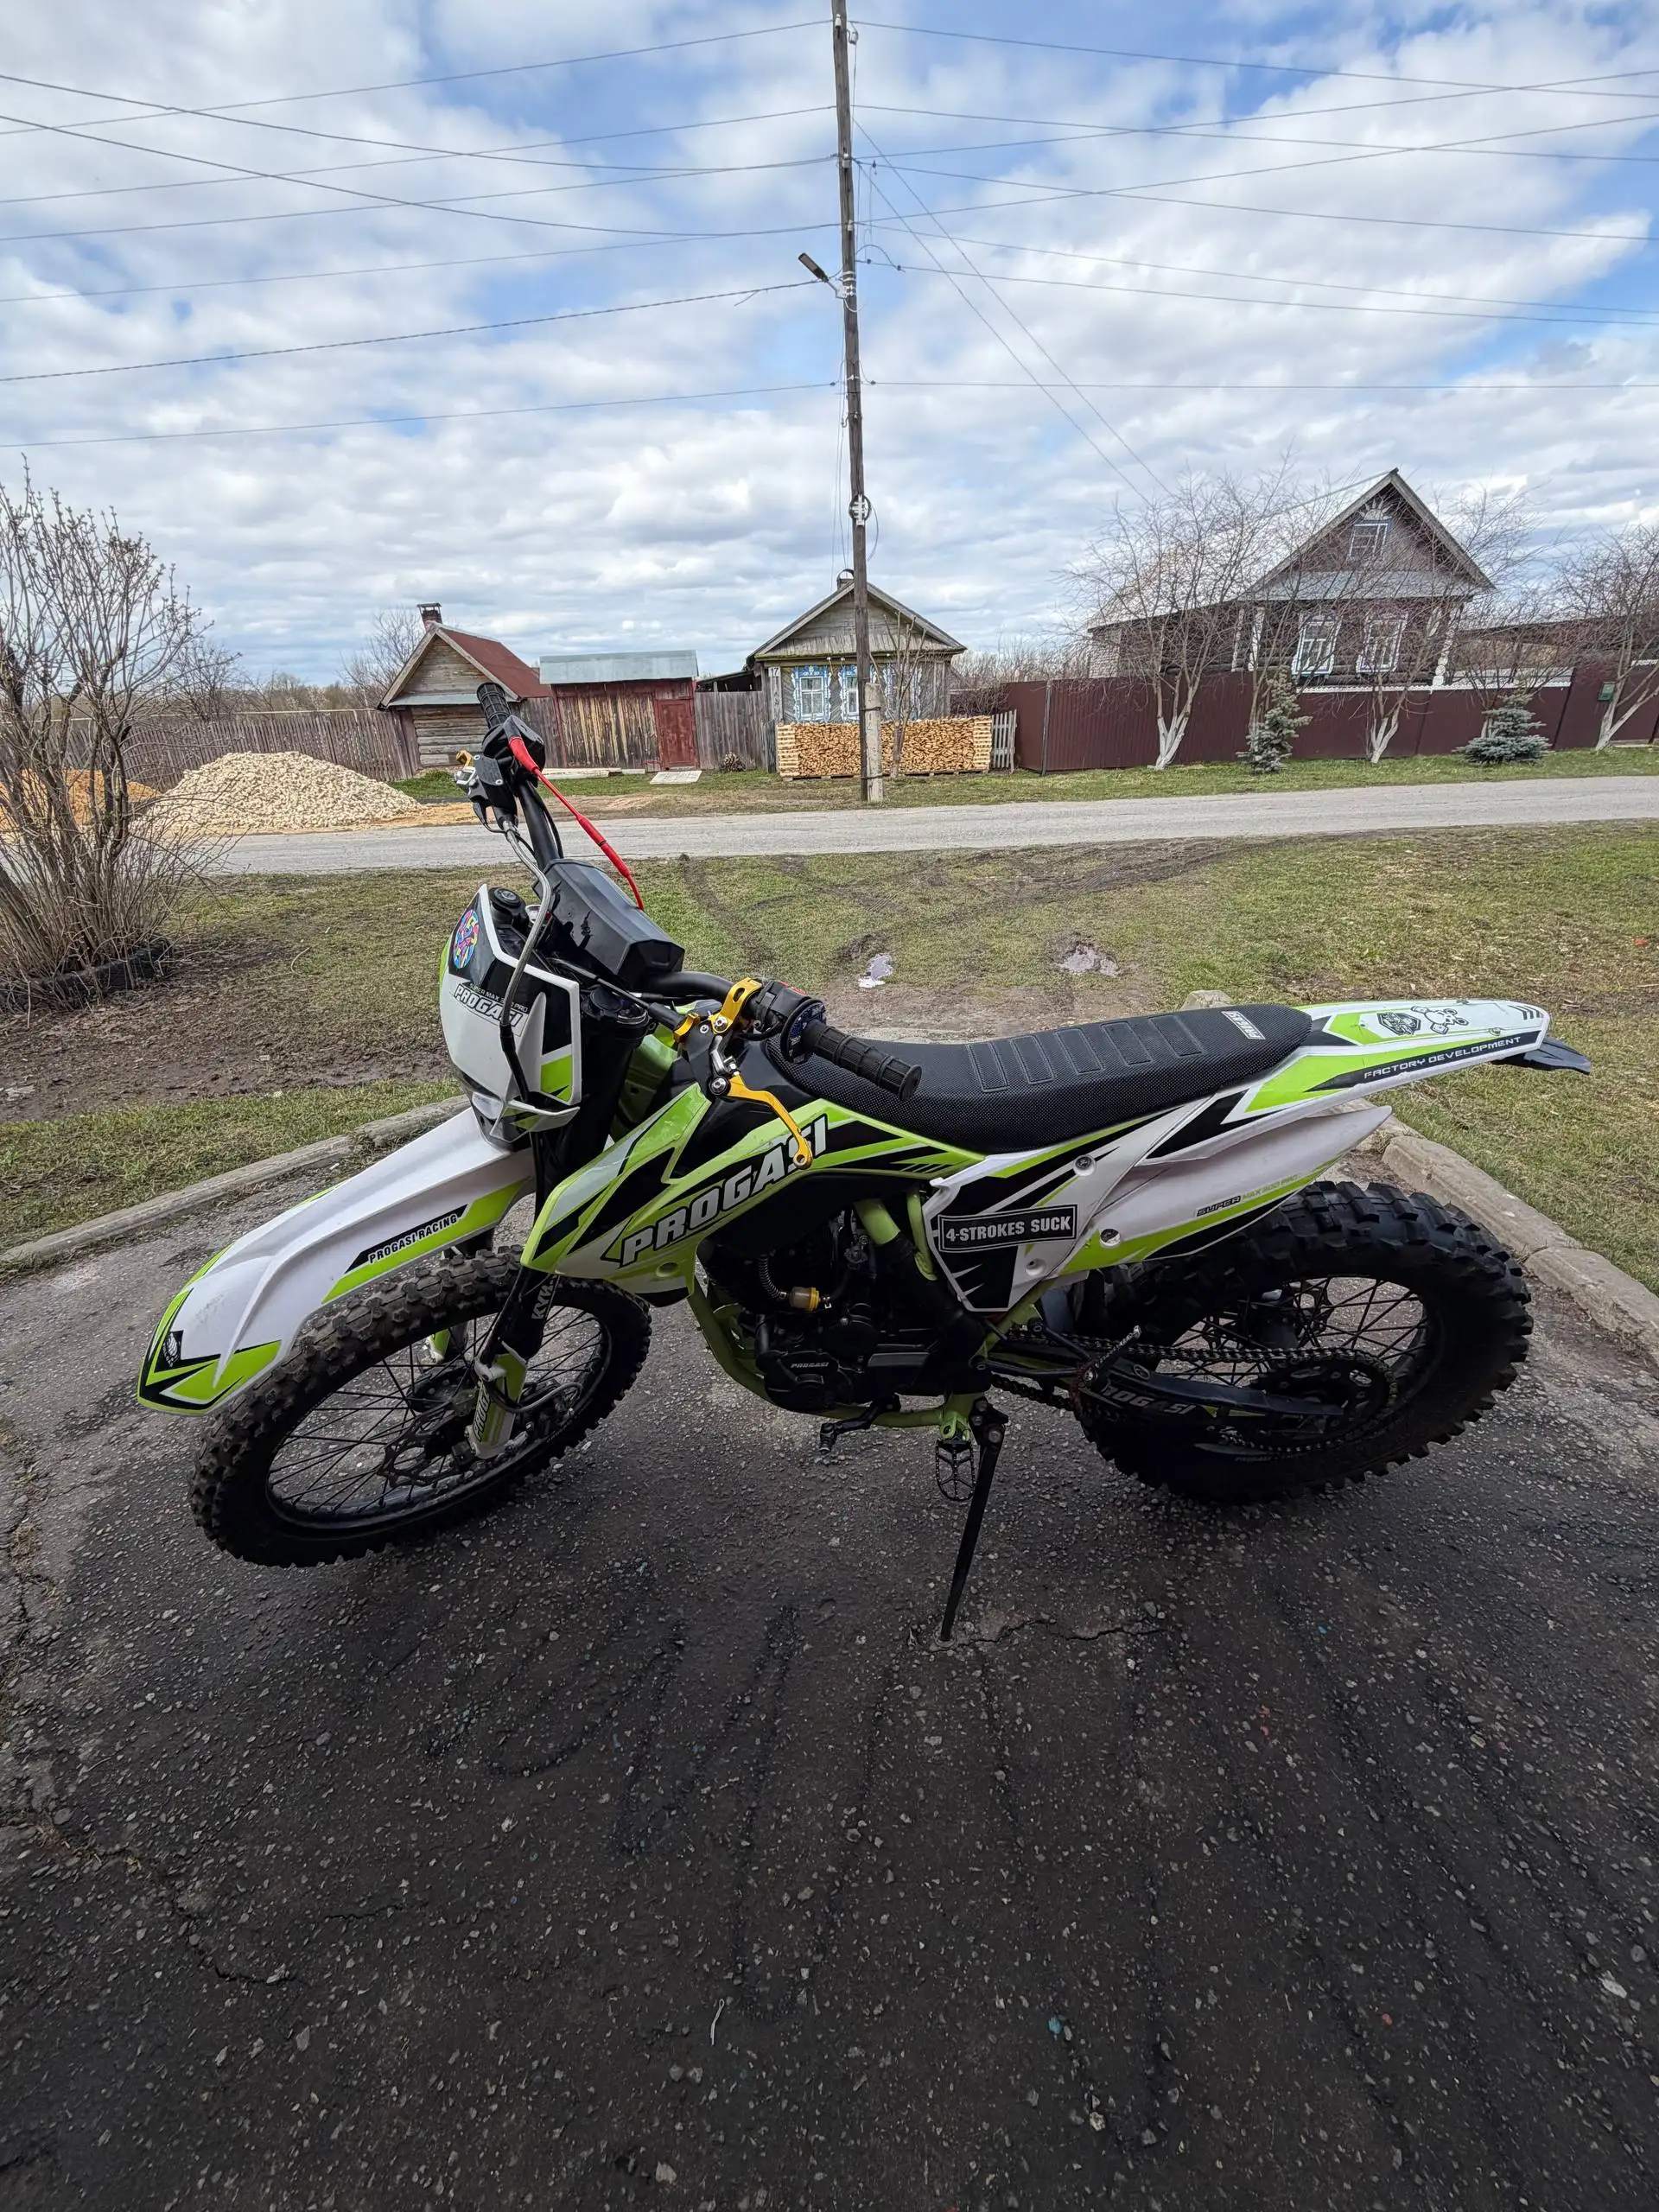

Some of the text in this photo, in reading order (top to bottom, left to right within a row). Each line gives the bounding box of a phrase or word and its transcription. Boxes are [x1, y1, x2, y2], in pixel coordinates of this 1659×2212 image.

[486, 991, 499, 1001] MAX
[514, 1003, 528, 1013] PRO
[1363, 1035, 1521, 1079] FACTORY DEVELOPMENT
[1197, 1196, 1241, 1217] SUPER
[369, 1213, 459, 1263] PROGASI RACING
[945, 1216, 1071, 1242] 4-STROKES SUCK
